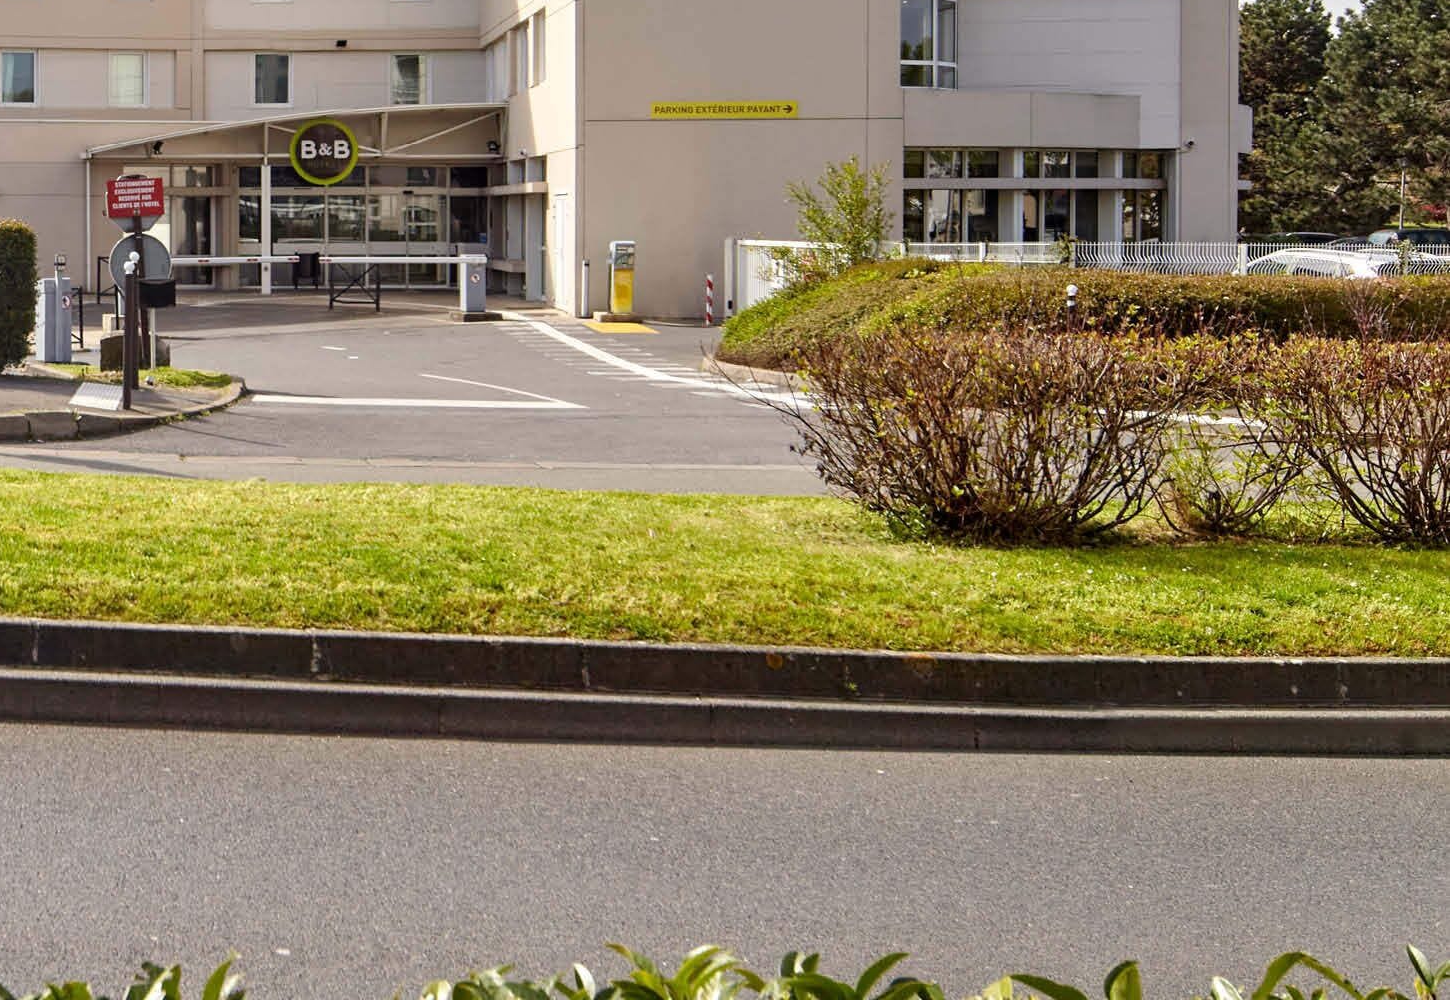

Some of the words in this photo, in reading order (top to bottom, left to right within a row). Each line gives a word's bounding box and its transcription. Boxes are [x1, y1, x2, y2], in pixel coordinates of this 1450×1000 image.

[654, 104, 693, 114] PARKING
[695, 103, 744, 114] EXTÉRIEUR
[747, 104, 781, 113] PAYANT
[301, 140, 350, 159] B&B
